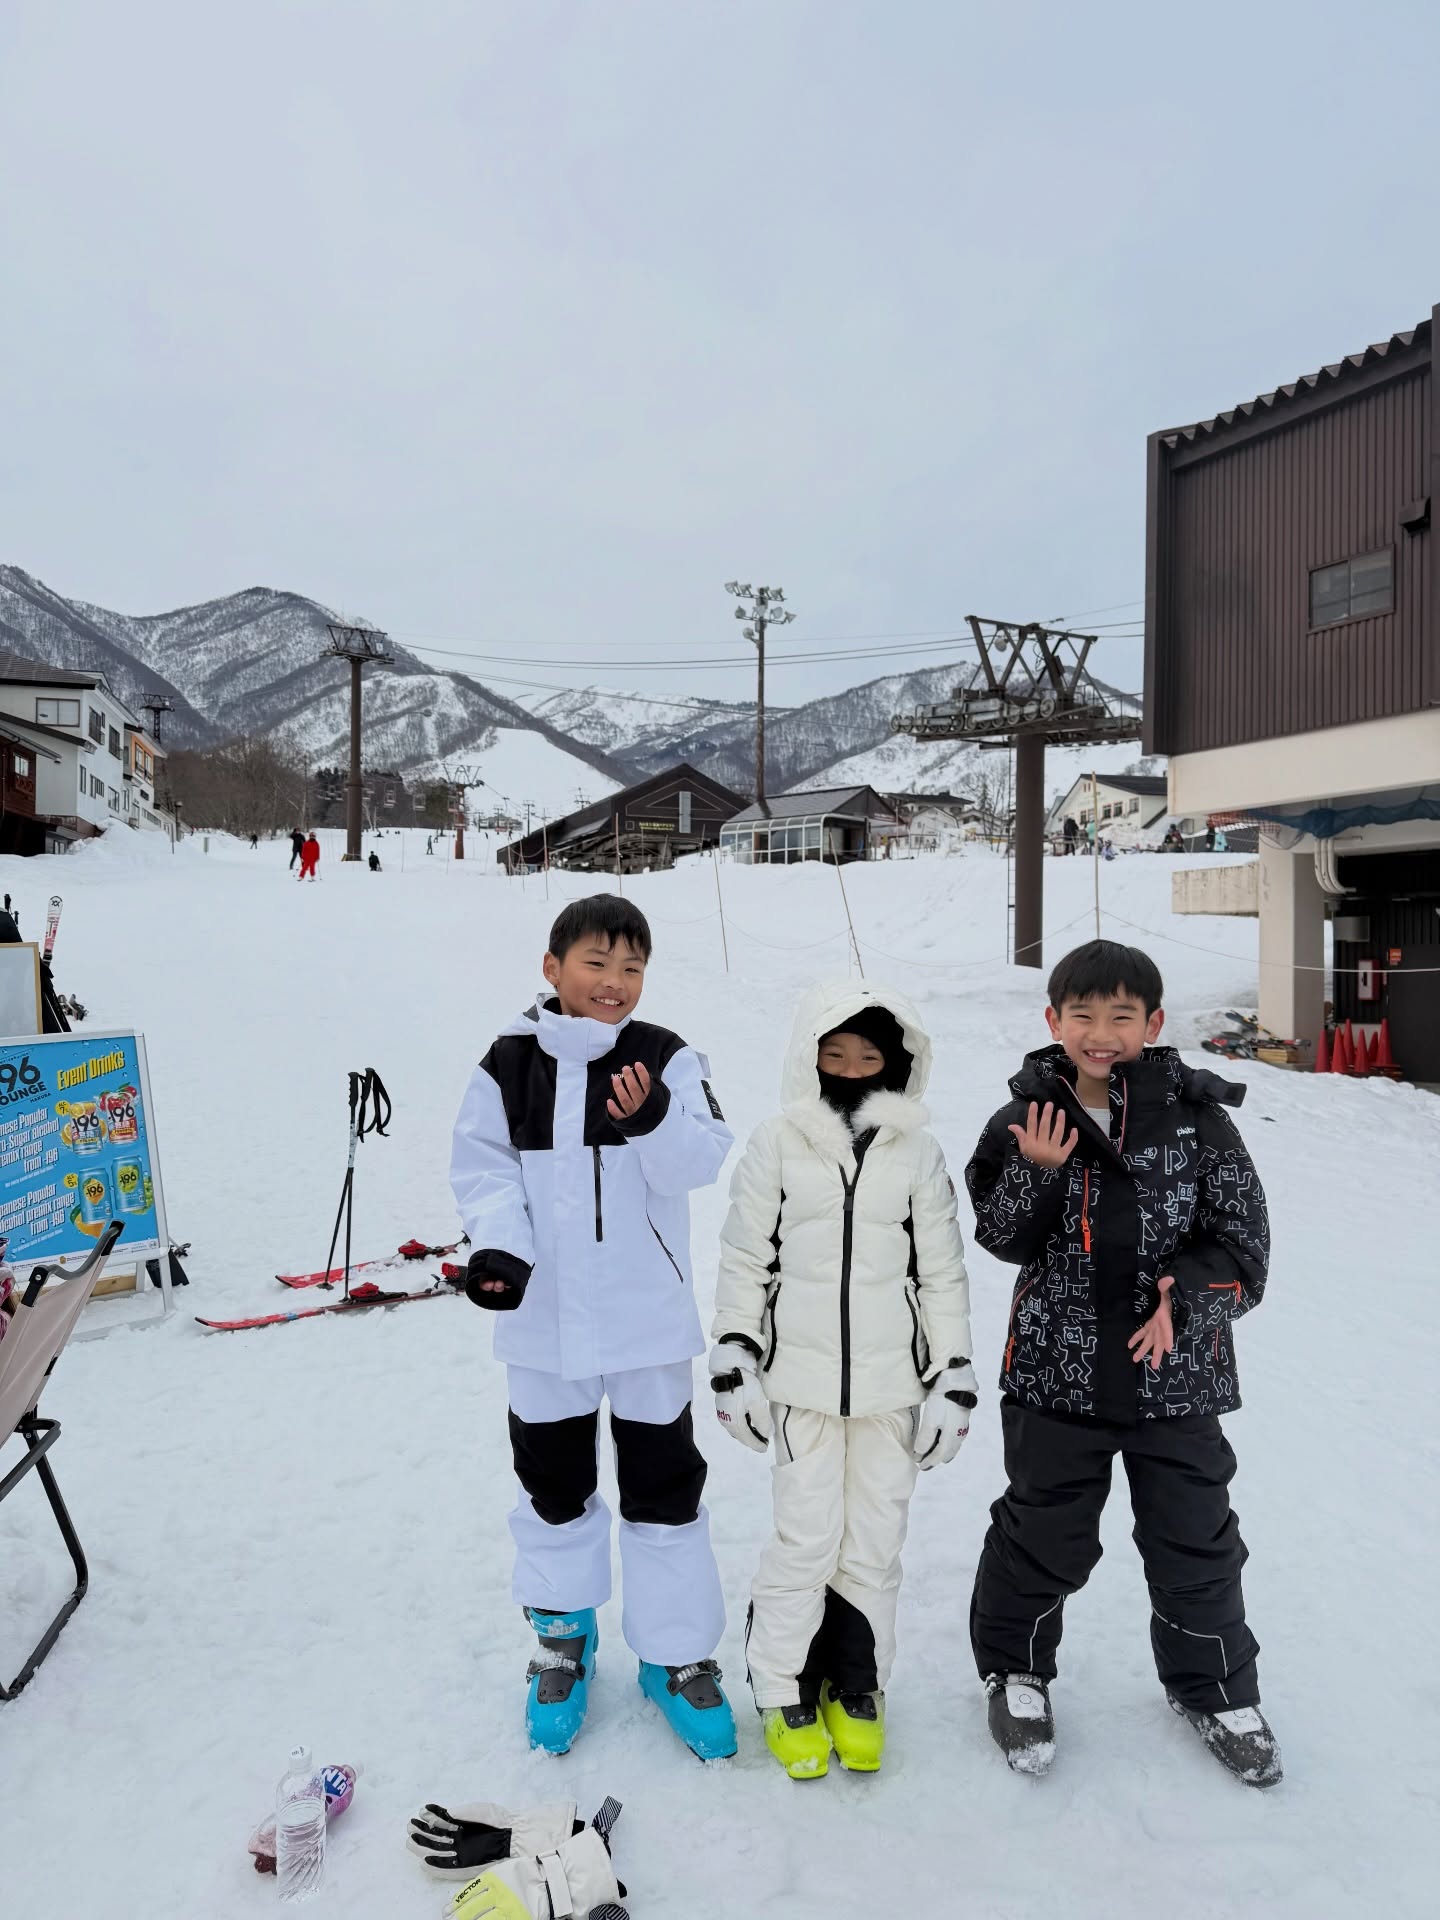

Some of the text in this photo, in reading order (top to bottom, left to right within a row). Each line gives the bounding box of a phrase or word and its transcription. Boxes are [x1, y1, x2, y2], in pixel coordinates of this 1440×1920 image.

[0, 1056, 40, 1093] 96
[57, 1050, 125, 1091] Event Drinks
[19, 1107, 48, 1129] Popular
[32, 1117, 60, 1140] alcohol
[21, 1140, 43, 1159] range
[24, 1156, 42, 1174] from
[27, 1184, 57, 1206] Popular
[26, 1201, 53, 1225] premix
[53, 1192, 75, 1212] range
[31, 1218, 49, 1236] from
[455, 1878, 481, 1903] VECTOR
